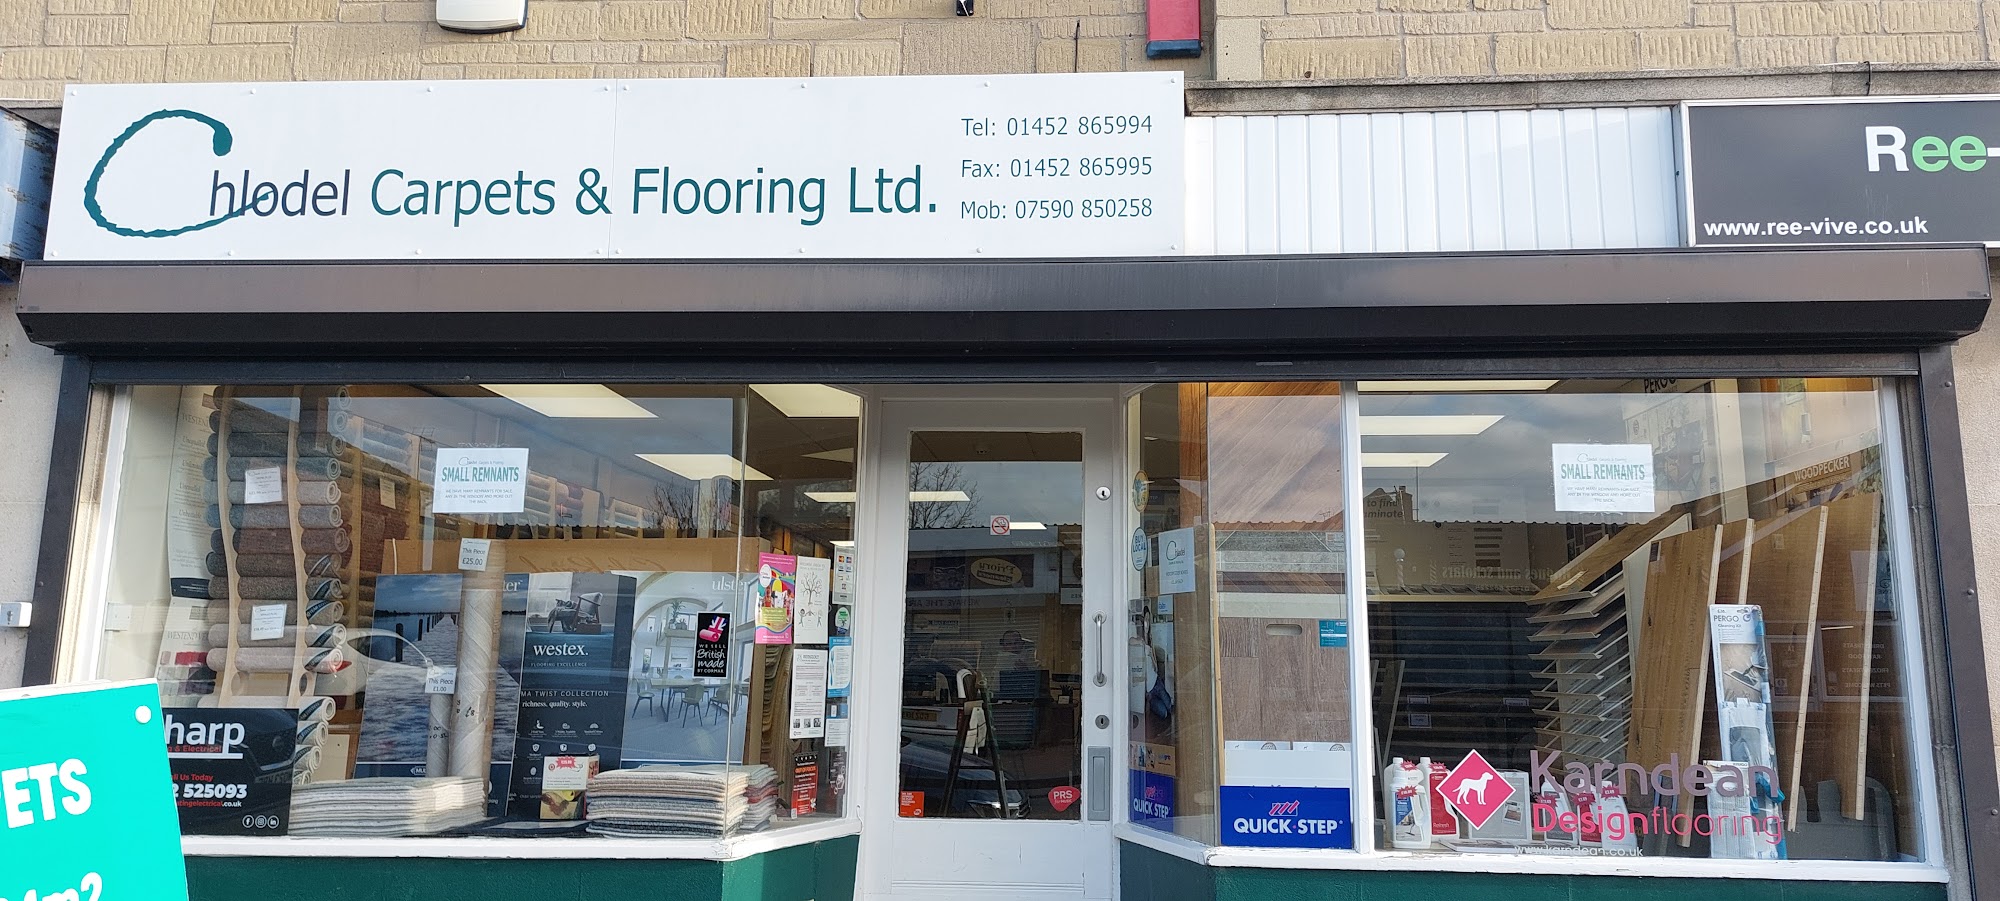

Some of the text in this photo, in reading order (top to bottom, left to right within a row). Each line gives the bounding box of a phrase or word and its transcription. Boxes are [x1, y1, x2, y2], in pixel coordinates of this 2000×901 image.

[961, 115, 1152, 137] Tel: 01452 865994
[84, 109, 936, 238] Chlodel Carpets & Flooring Ltd.
[961, 156, 1152, 178] Fax: 01452 865995
[961, 197, 1152, 220] Mob: 07590 850258
[1704, 216, 1929, 236] www.ree-vive.co.uk
[442, 467, 520, 482] SMALL REMNANTS
[1560, 463, 1646, 480] SMALL REMNANTS
[1793, 456, 1850, 482] WOODPECKER
[1380, 499, 1398, 508] find
[1135, 535, 1144, 544] BUY
[1133, 544, 1147, 553] LOCAL
[462, 557, 483, 566] £25.00
[697, 649, 726, 659] British
[697, 659, 725, 668] made
[165, 714, 245, 754] harp
[191, 774, 213, 782] Today
[1530, 750, 1779, 798] Karndean
[0, 758, 92, 829] ETS
[183, 783, 248, 799] 525093
[1053, 790, 1073, 799] PRS
[1532, 803, 1782, 846] Designflooring
[1514, 845, 1644, 857] www.karndean.co.uk
